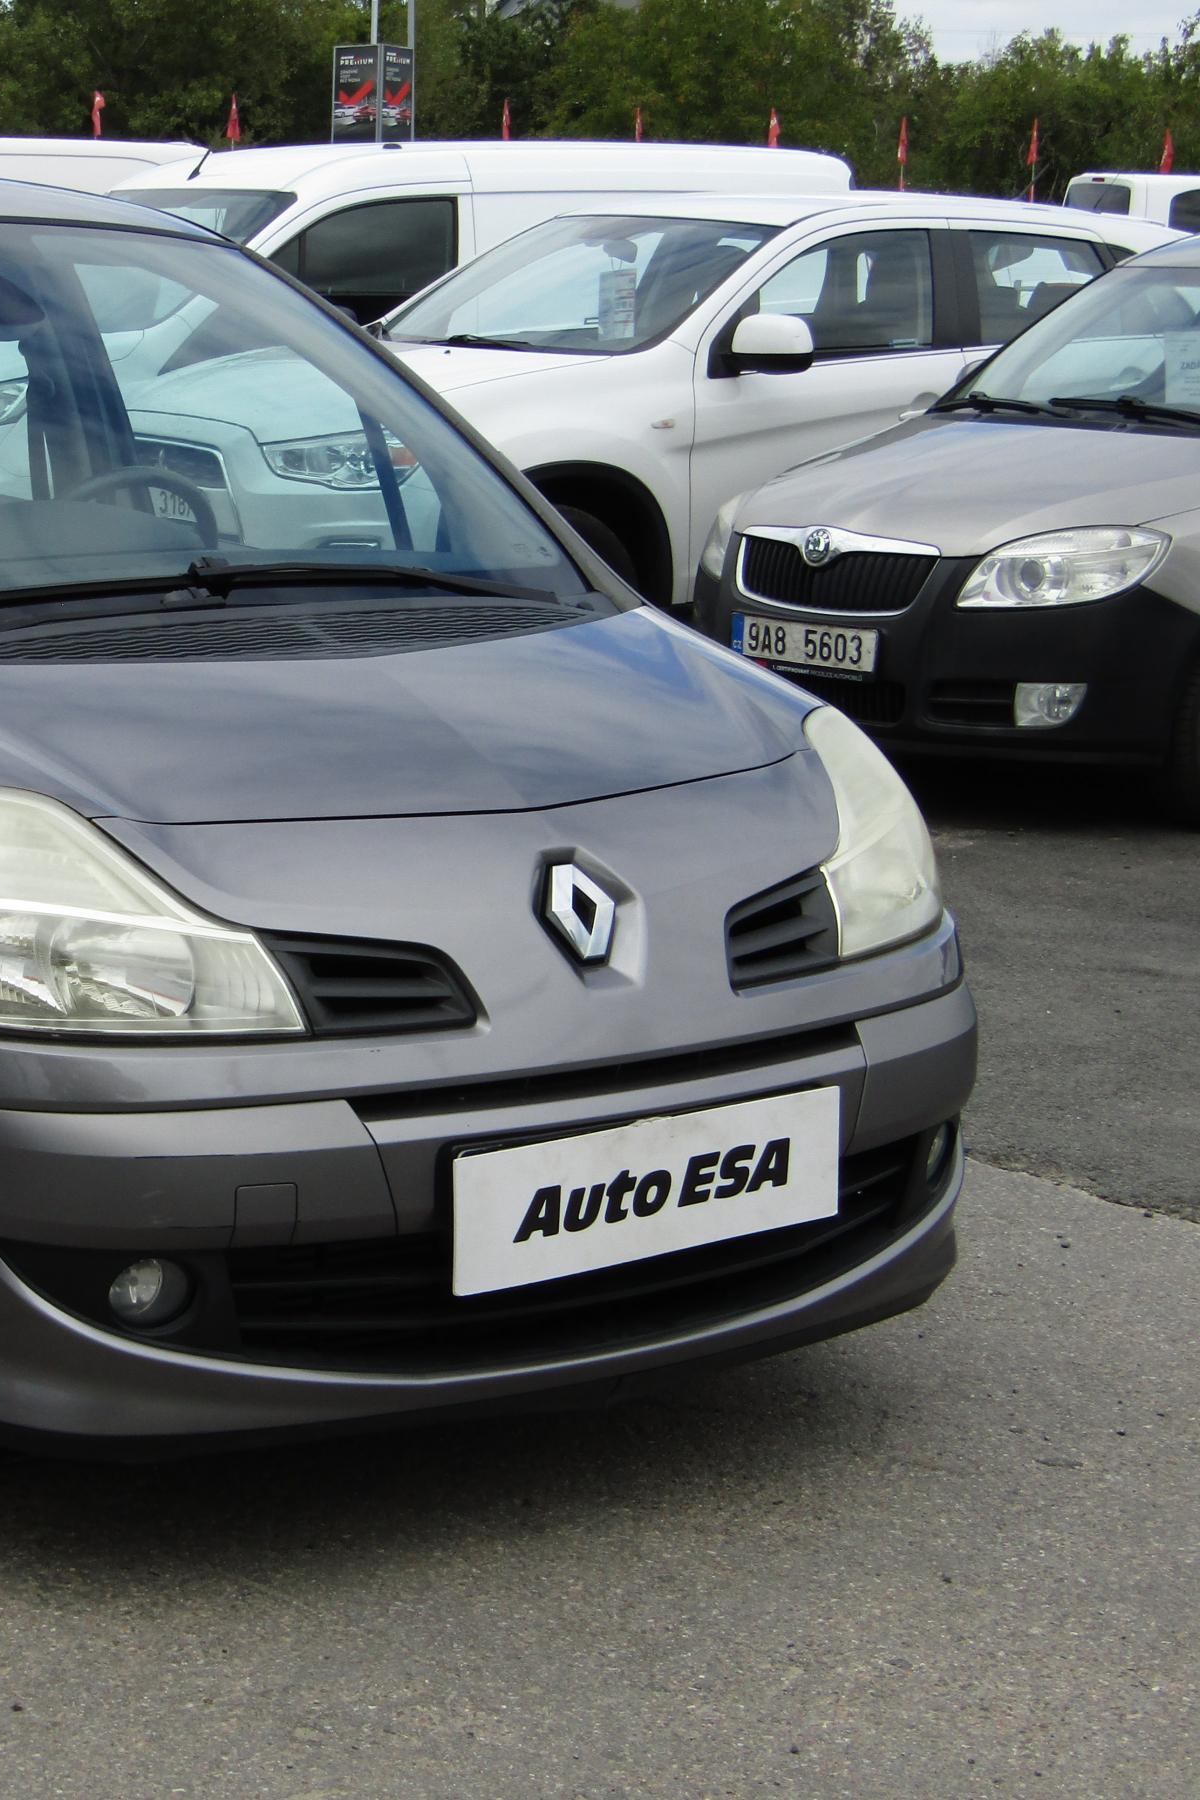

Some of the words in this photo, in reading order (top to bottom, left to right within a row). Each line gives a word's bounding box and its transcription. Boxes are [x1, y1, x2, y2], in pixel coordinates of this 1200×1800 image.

[748, 622, 787, 656] 9A8
[803, 628, 863, 665] 5603
[512, 1168, 672, 1244] Auto
[677, 1137, 791, 1209] ESA
